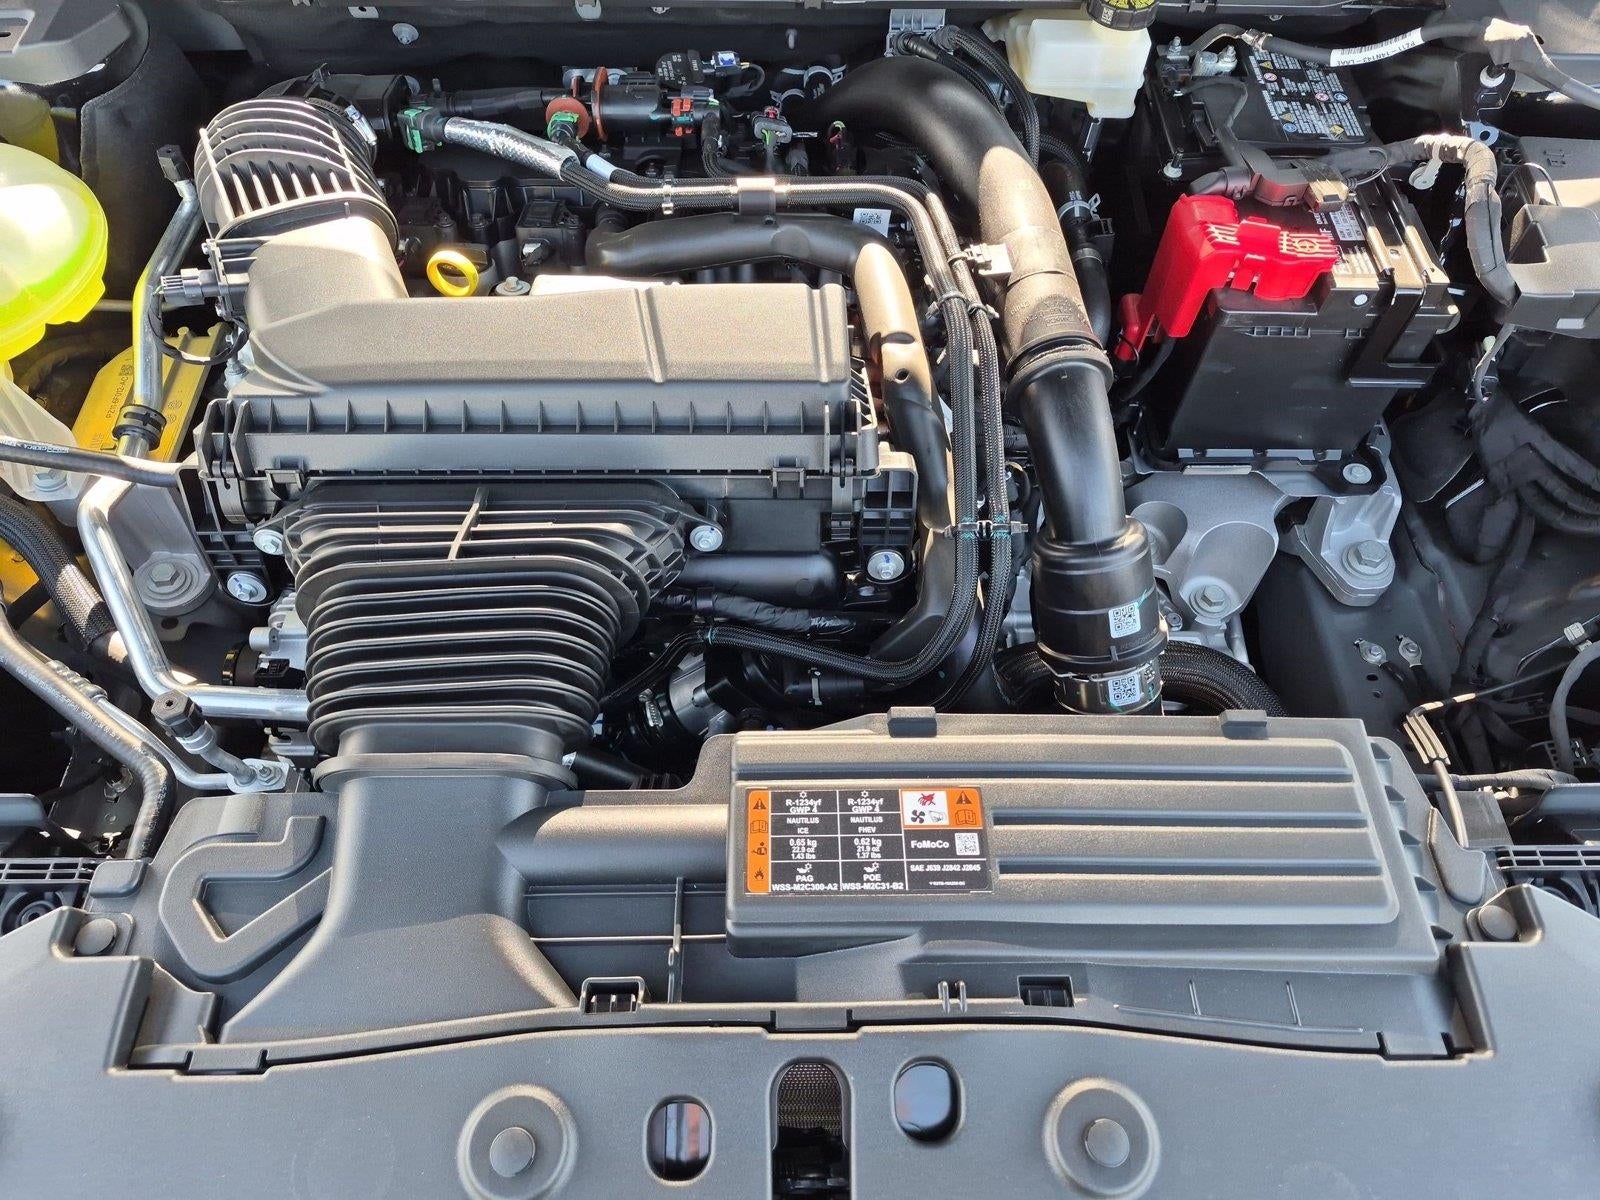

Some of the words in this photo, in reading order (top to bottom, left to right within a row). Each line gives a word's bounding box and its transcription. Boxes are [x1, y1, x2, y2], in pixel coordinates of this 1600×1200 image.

[786, 798, 822, 808] R-1234yf
[848, 798, 884, 807] R-1234yf
[790, 838, 806, 846] 0.65
[806, 838, 818, 848] kg
[854, 838, 870, 846] 0.62
[871, 837, 882, 847] kg
[910, 840, 949, 849] FoMoCo
[795, 874, 814, 882] PAG
